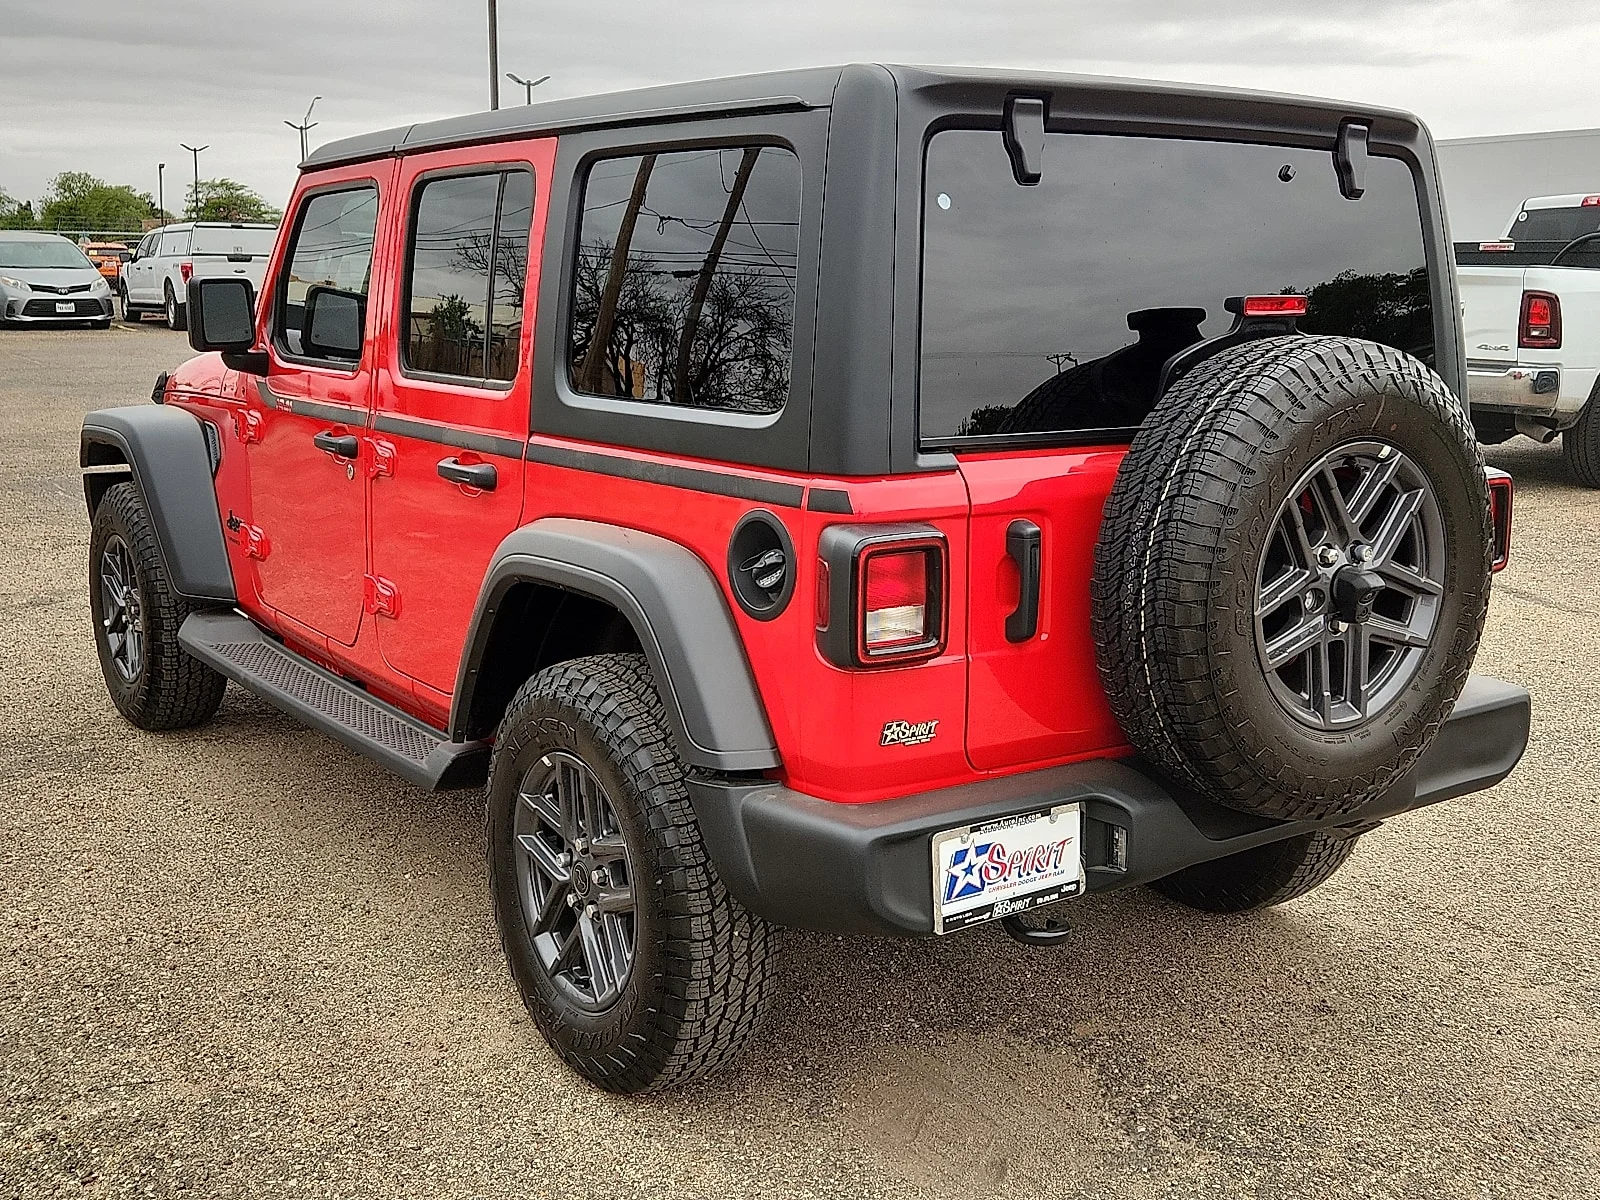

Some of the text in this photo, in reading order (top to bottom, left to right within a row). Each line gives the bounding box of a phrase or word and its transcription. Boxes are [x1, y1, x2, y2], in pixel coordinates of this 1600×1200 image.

[507, 717, 578, 763] NEXEN
[984, 837, 1074, 882] SPIRIT
[1017, 876, 1037, 886] DODGE
[1060, 883, 1077, 893] Jeep
